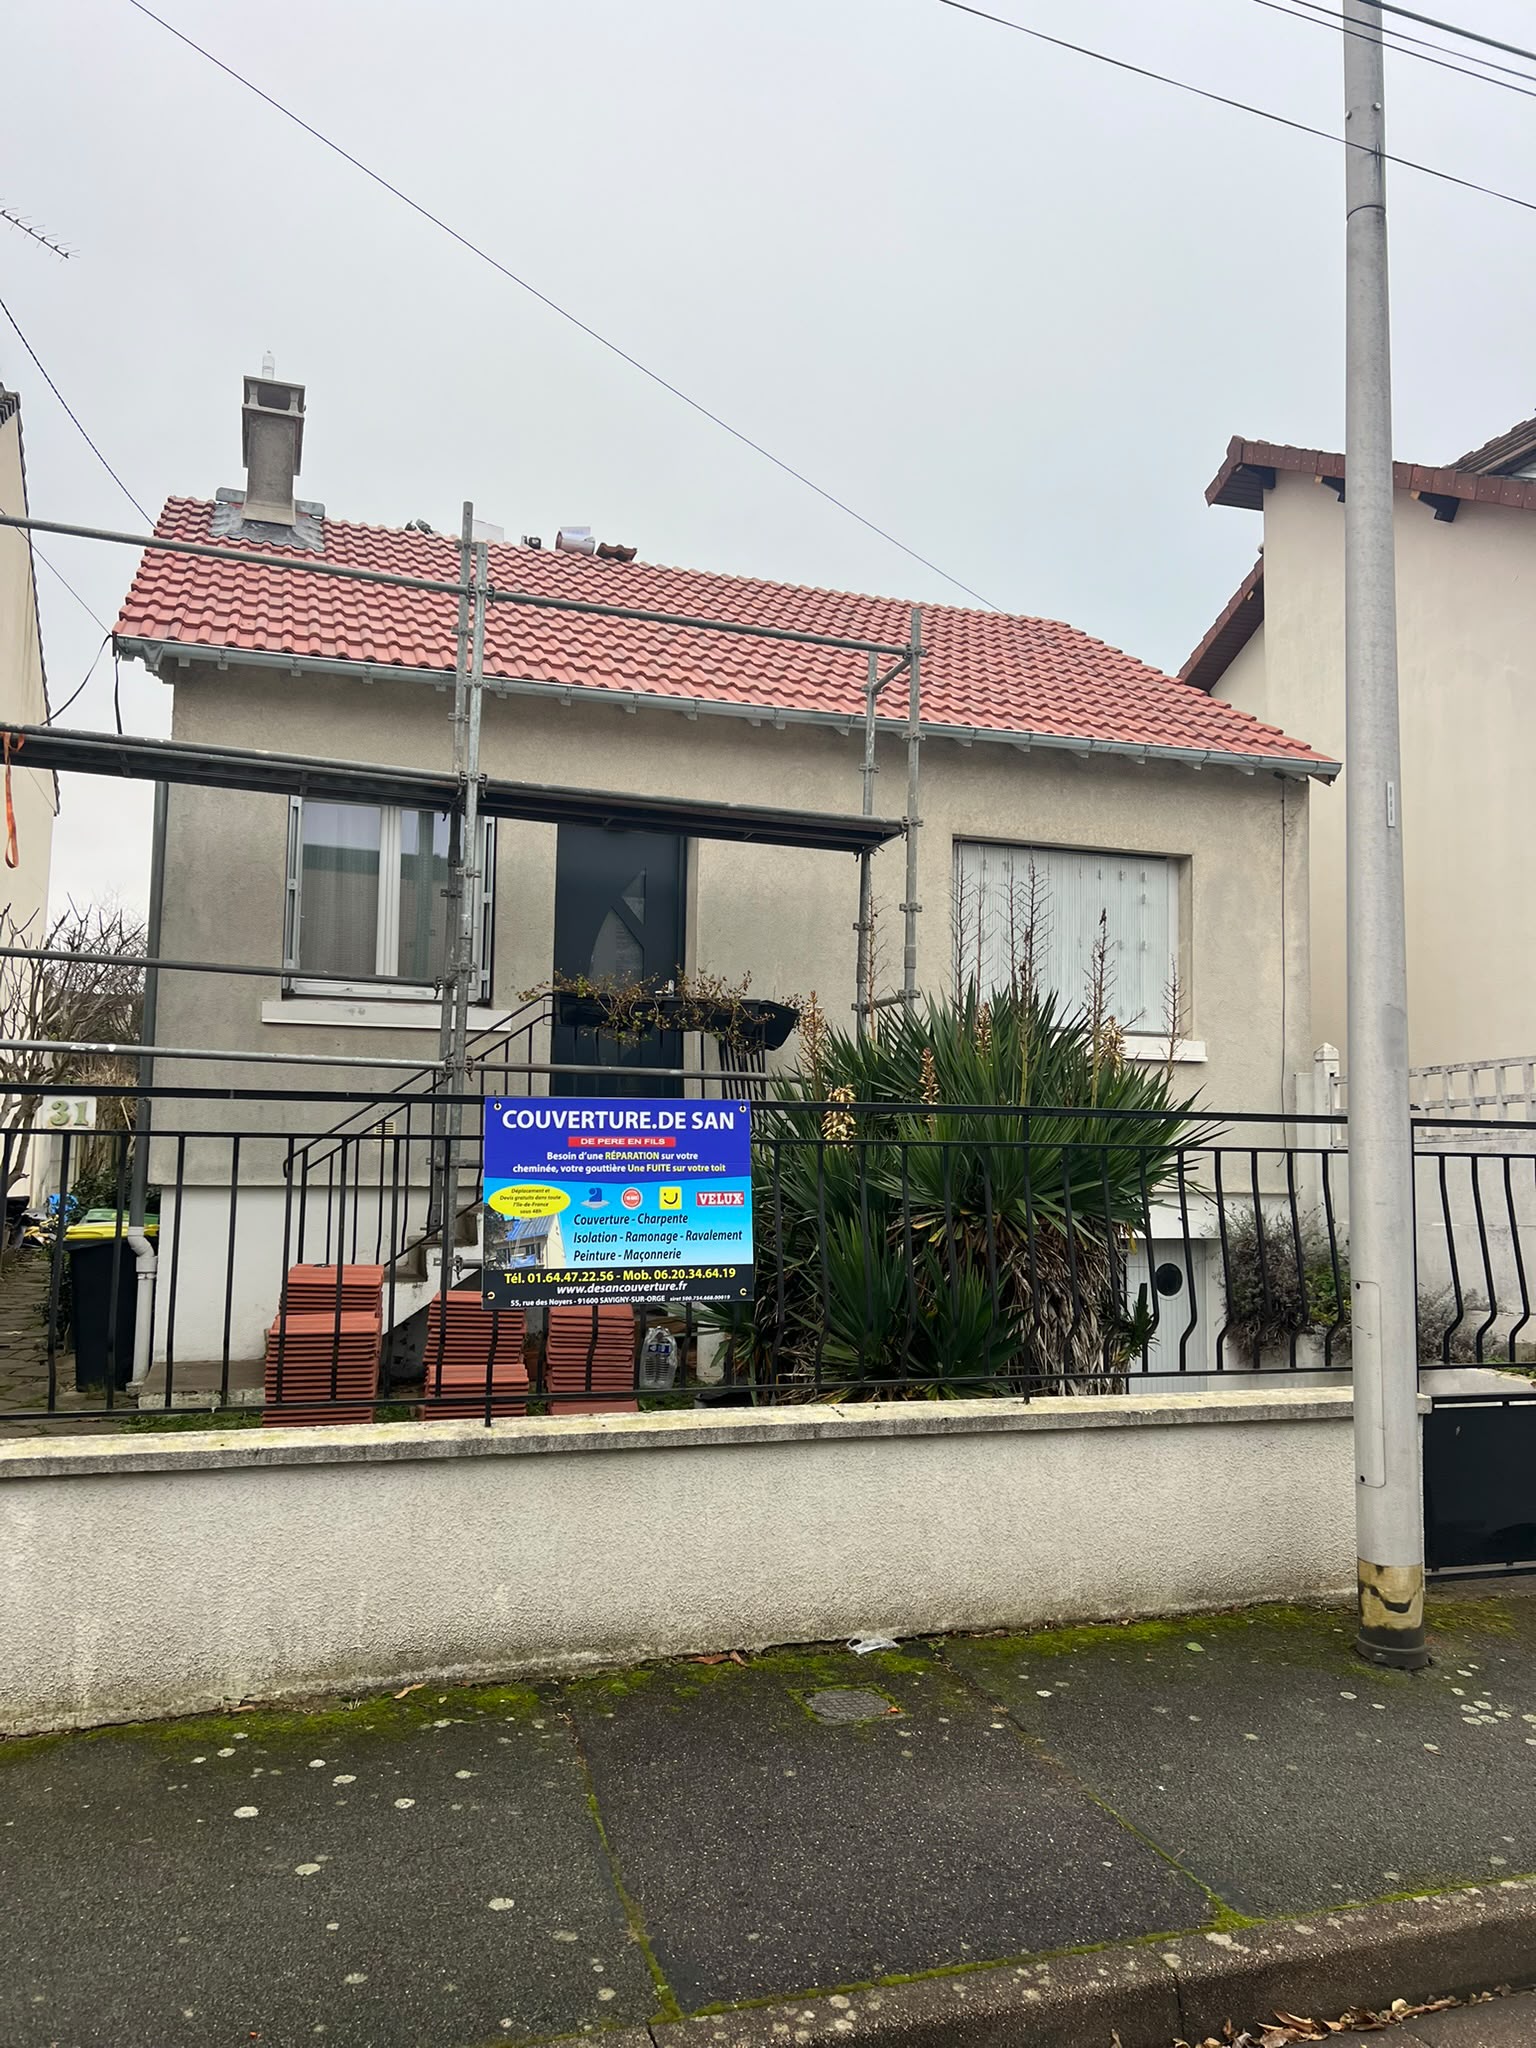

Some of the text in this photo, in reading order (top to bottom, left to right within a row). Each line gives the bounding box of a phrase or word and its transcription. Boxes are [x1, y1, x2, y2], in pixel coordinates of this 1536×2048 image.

[50, 1100, 89, 1126] 31
[502, 1110, 734, 1130] COUVERTURE.DE SAN
[546, 1152, 576, 1160] Besoin
[605, 1150, 659, 1160] RÉPARATION
[676, 1152, 698, 1160] votre
[512, 1164, 558, 1174] cheminée,
[560, 1165, 584, 1173] votre
[585, 1164, 626, 1175] gouttière
[627, 1164, 645, 1172] Une
[647, 1164, 671, 1172] FUITE
[710, 1164, 726, 1172] toit
[698, 1193, 740, 1205] VELUX
[574, 1214, 630, 1225] Couverture
[638, 1213, 688, 1226] Charpente
[574, 1232, 618, 1243] Isolation
[626, 1231, 678, 1244] Ramonage
[686, 1230, 742, 1241] Ravalement
[574, 1250, 616, 1261] Peinture
[624, 1248, 682, 1263] Maçonnerie
[504, 1273, 524, 1284] Tél.
[528, 1272, 614, 1283] 01.64.47.22.56
[623, 1270, 652, 1281] Mob.
[654, 1267, 736, 1280] 06.20.34.64.19
[557, 1281, 688, 1295] www.desancouverture.fr
[549, 1299, 573, 1307] Noyers
[600, 1295, 666, 1304] SAVIGNY-SUR-ORGE
